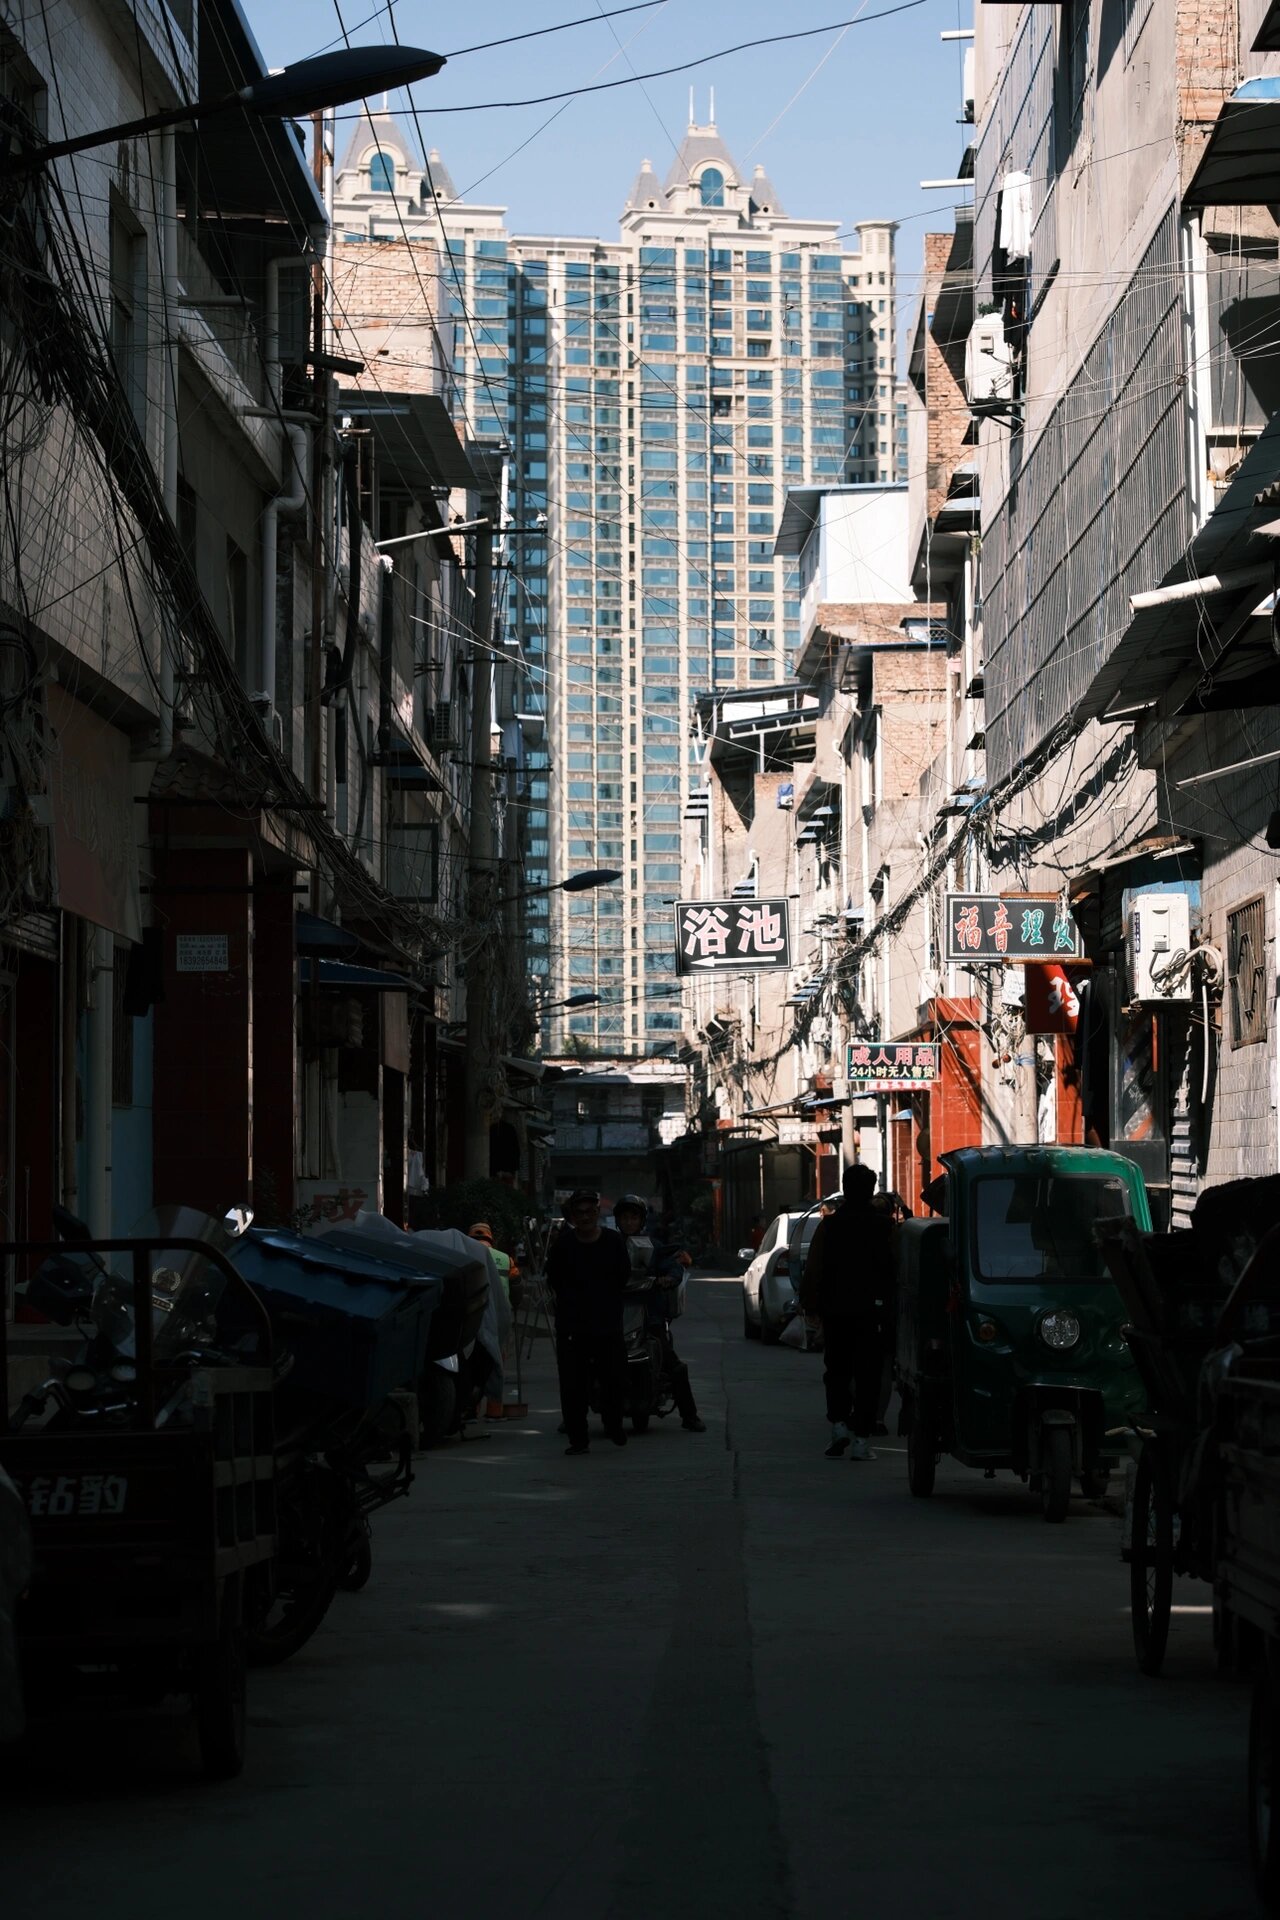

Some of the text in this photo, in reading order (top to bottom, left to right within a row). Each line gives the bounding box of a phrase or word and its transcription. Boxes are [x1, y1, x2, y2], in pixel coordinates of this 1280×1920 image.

[683, 905, 785, 956] 浴池
[955, 902, 1075, 953] 福音理发
[850, 1066, 935, 1078] 24小时无人售货
[851, 1046, 934, 1066] 成人用品
